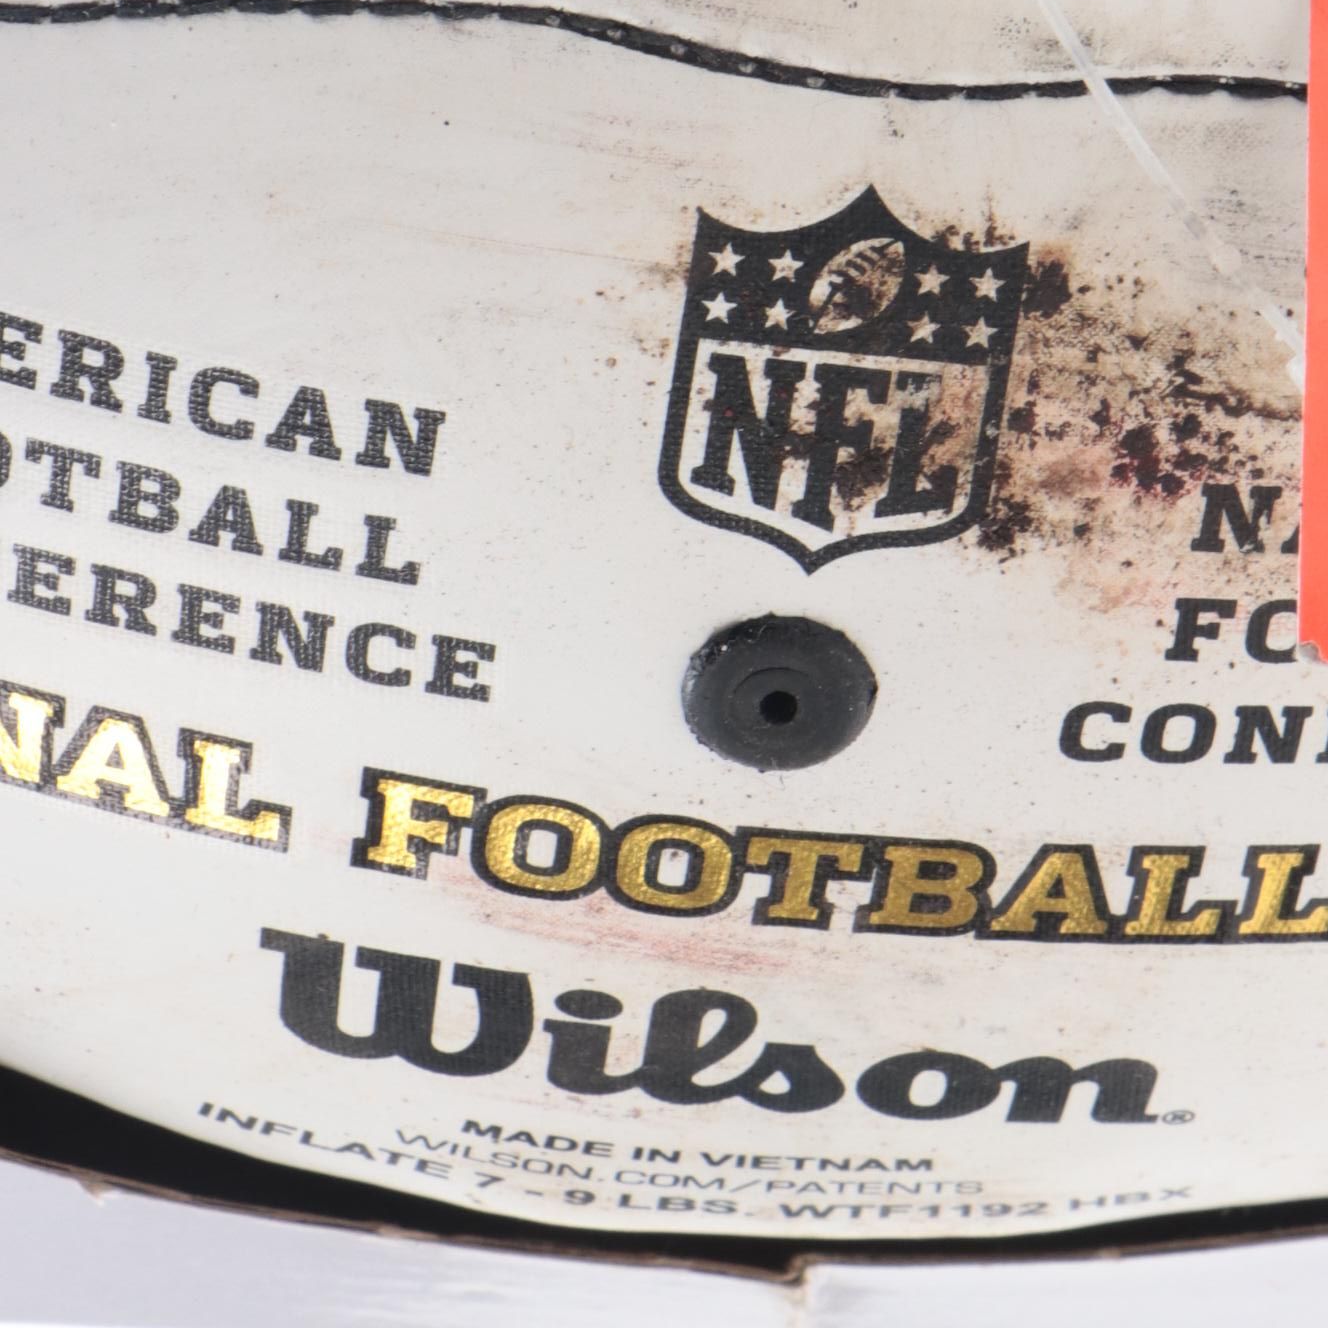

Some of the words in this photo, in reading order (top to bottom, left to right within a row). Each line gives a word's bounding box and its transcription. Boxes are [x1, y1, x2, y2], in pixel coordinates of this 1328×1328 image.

[0, 430, 421, 586] TBALL
[690, 352, 958, 534] NFL
[7, 543, 496, 702] ERENCE
[196, 1101, 453, 1179] INFLATE
[473, 1171, 505, 1191] 7
[564, 1188, 596, 1207] 9
[394, 1128, 985, 1196] WILSON.COM/PATENTS
[461, 1119, 615, 1159] MADE
[631, 1146, 682, 1165] IN
[700, 1151, 934, 1172] VIETNAM
